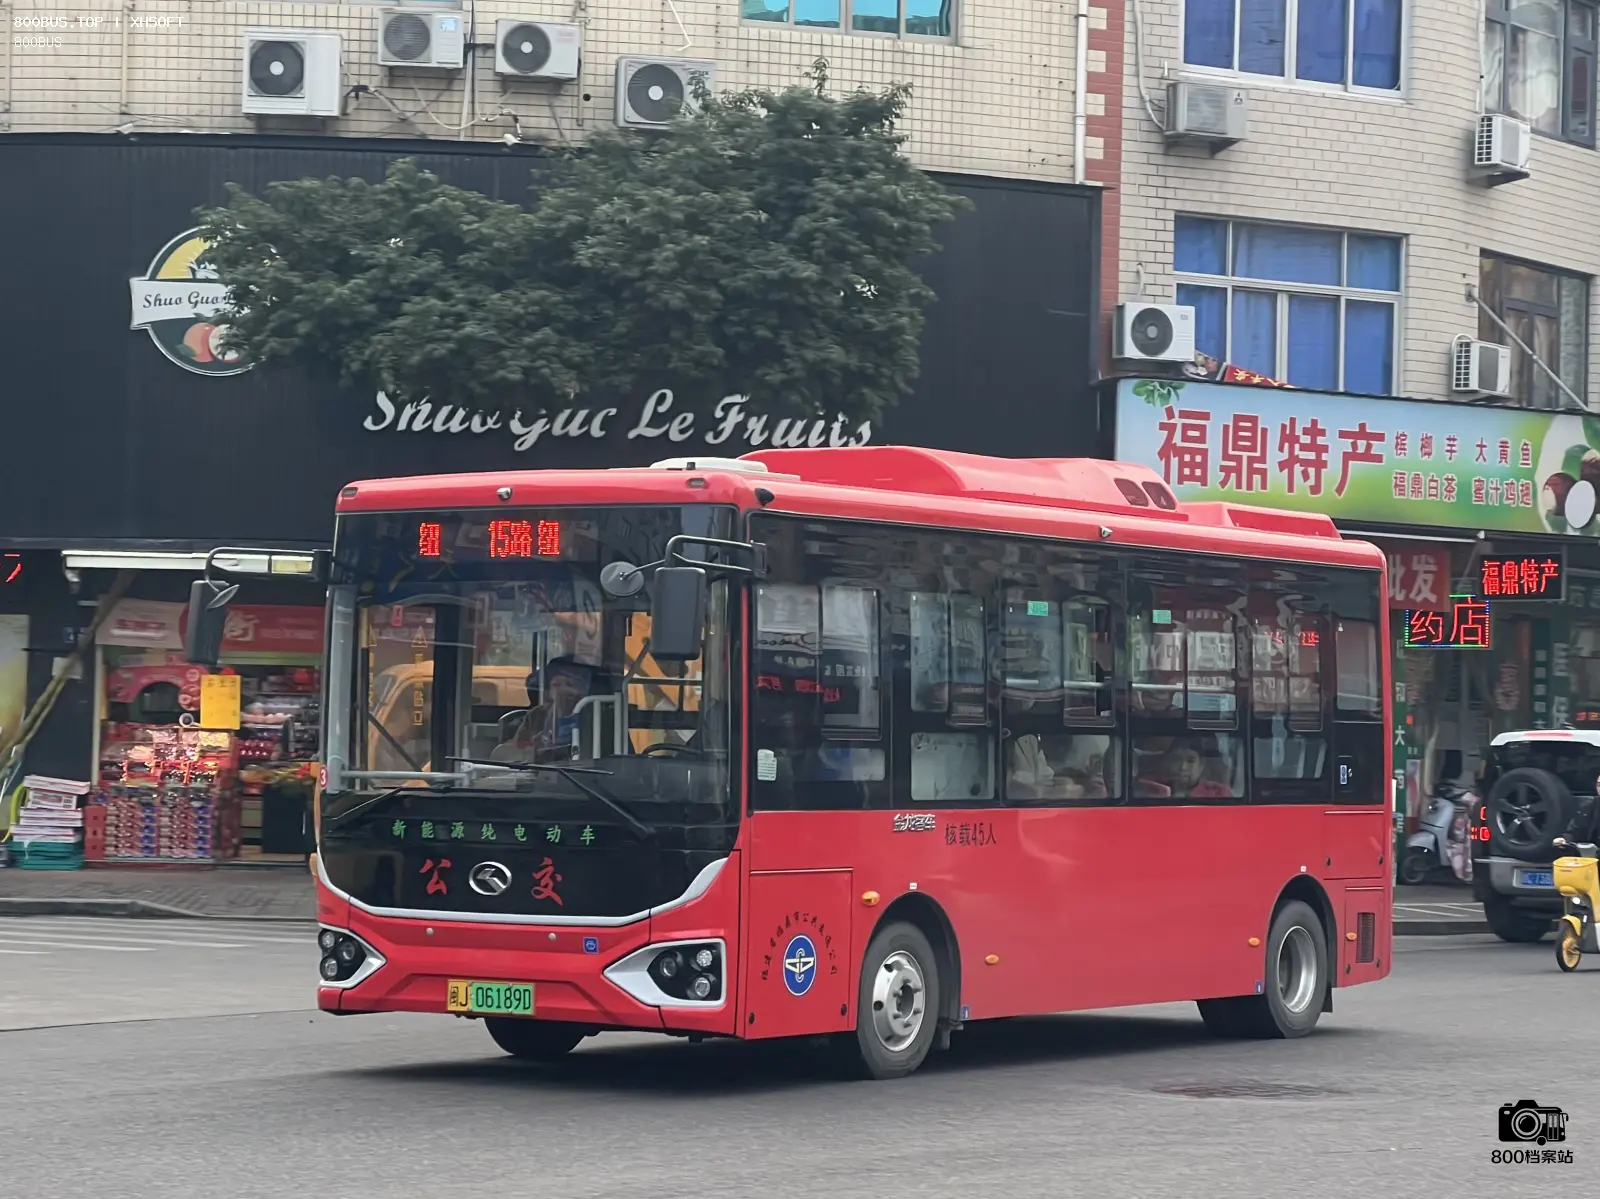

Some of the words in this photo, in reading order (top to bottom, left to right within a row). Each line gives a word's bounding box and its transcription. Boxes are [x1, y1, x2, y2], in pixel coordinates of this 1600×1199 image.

[143, 293, 183, 308] Shuo
[188, 291, 220, 309] Guo
[627, 388, 694, 442] Le
[704, 393, 872, 447] Fruits
[1157, 404, 1386, 498] 福鼎特产
[1475, 437, 1532, 467] 大黄鱼
[1393, 471, 1457, 502] 福鼎白茶
[1481, 558, 1559, 596] 福鼎特产
[320, 768, 327, 786] 3
[392, 819, 596, 845] 新能源纯电动车
[945, 823, 997, 846] 核载45人
[419, 858, 452, 895] 公
[531, 857, 564, 907] 交
